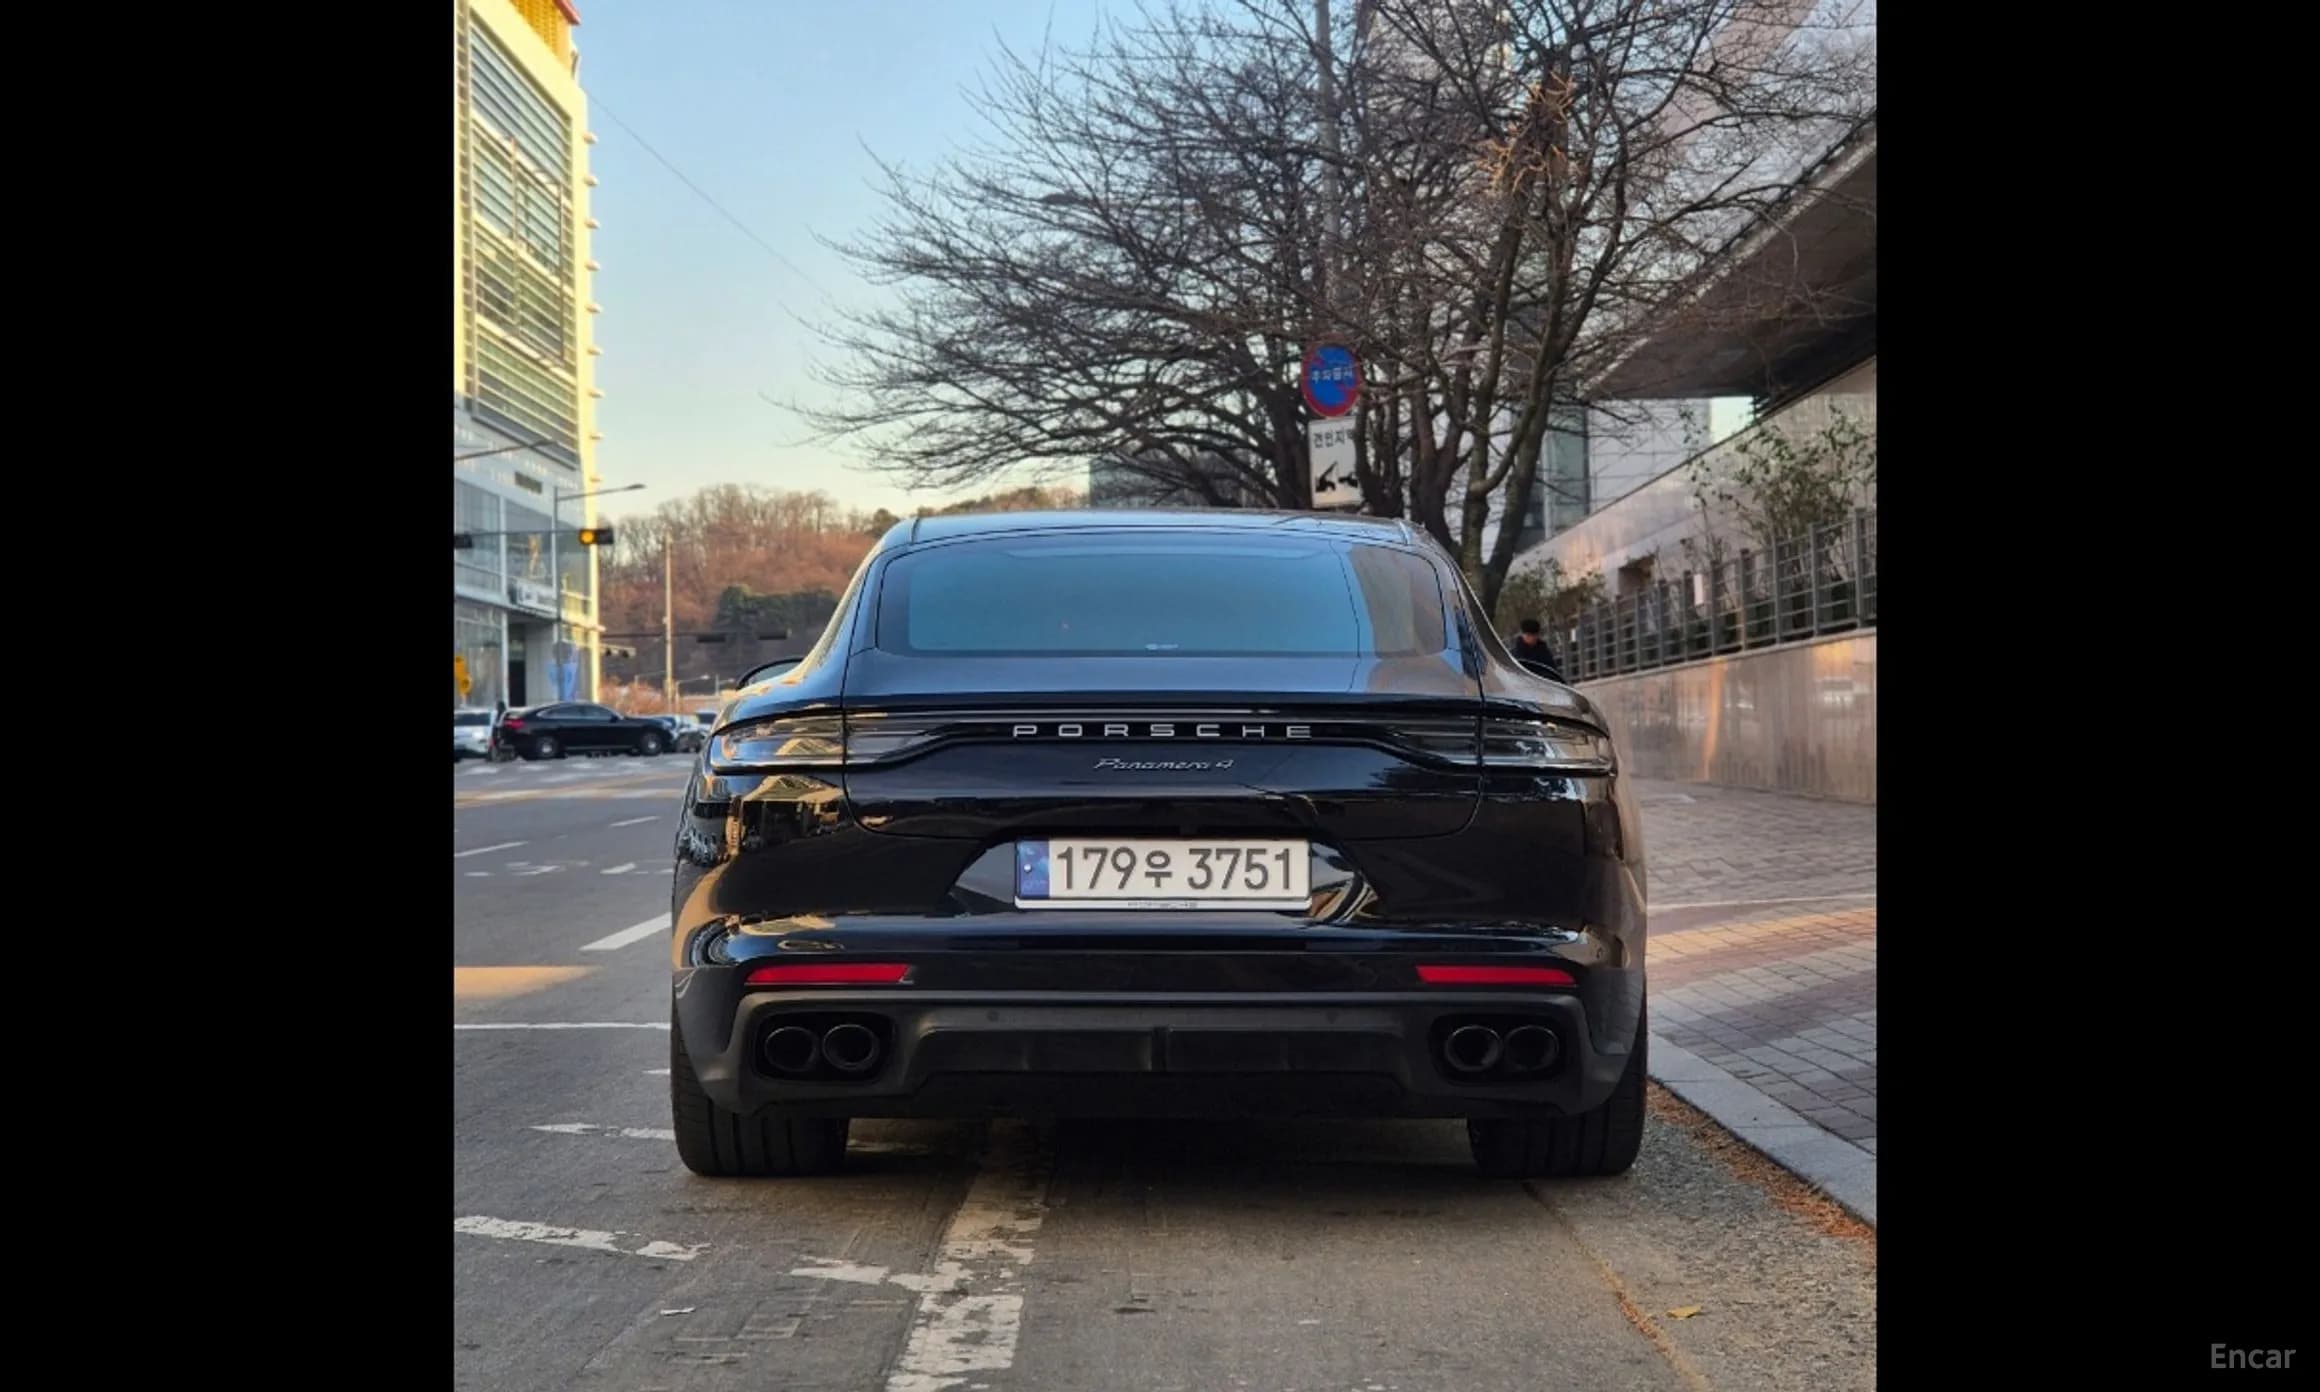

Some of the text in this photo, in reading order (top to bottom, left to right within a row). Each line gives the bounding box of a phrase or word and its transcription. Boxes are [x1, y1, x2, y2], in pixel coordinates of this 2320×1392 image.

[1013, 724, 1311, 738] PORSCHE
[1093, 758, 1235, 769] Panamera 4
[1056, 847, 1291, 890] 179우 3751
